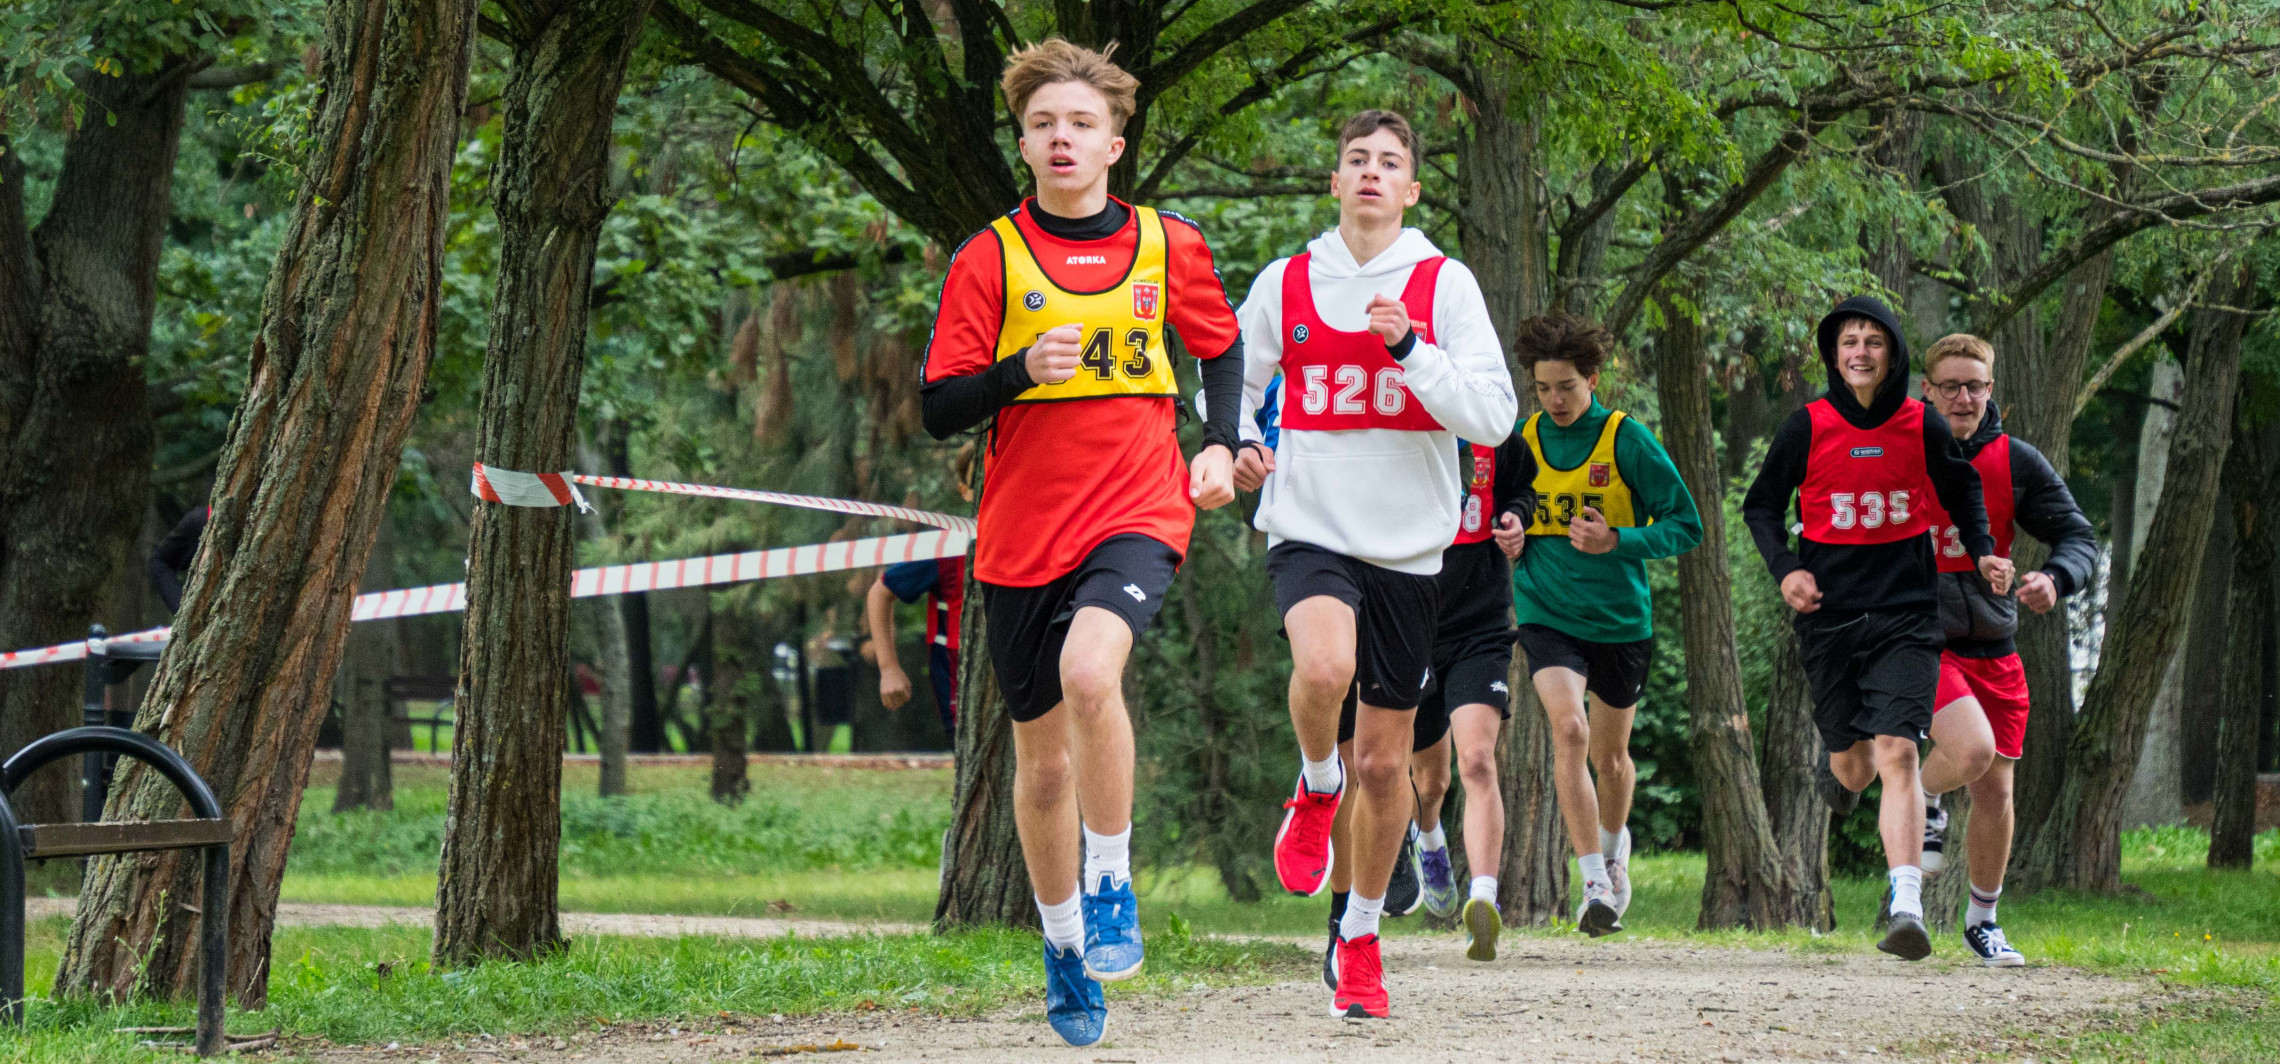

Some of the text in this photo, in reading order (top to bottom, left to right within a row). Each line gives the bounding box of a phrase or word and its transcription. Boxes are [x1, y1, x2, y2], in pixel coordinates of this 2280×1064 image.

[1066, 255, 1106, 265] ATORKA
[1036, 327, 1154, 385] 43
[1302, 364, 1406, 416] 526
[1831, 490, 1911, 530] 535
